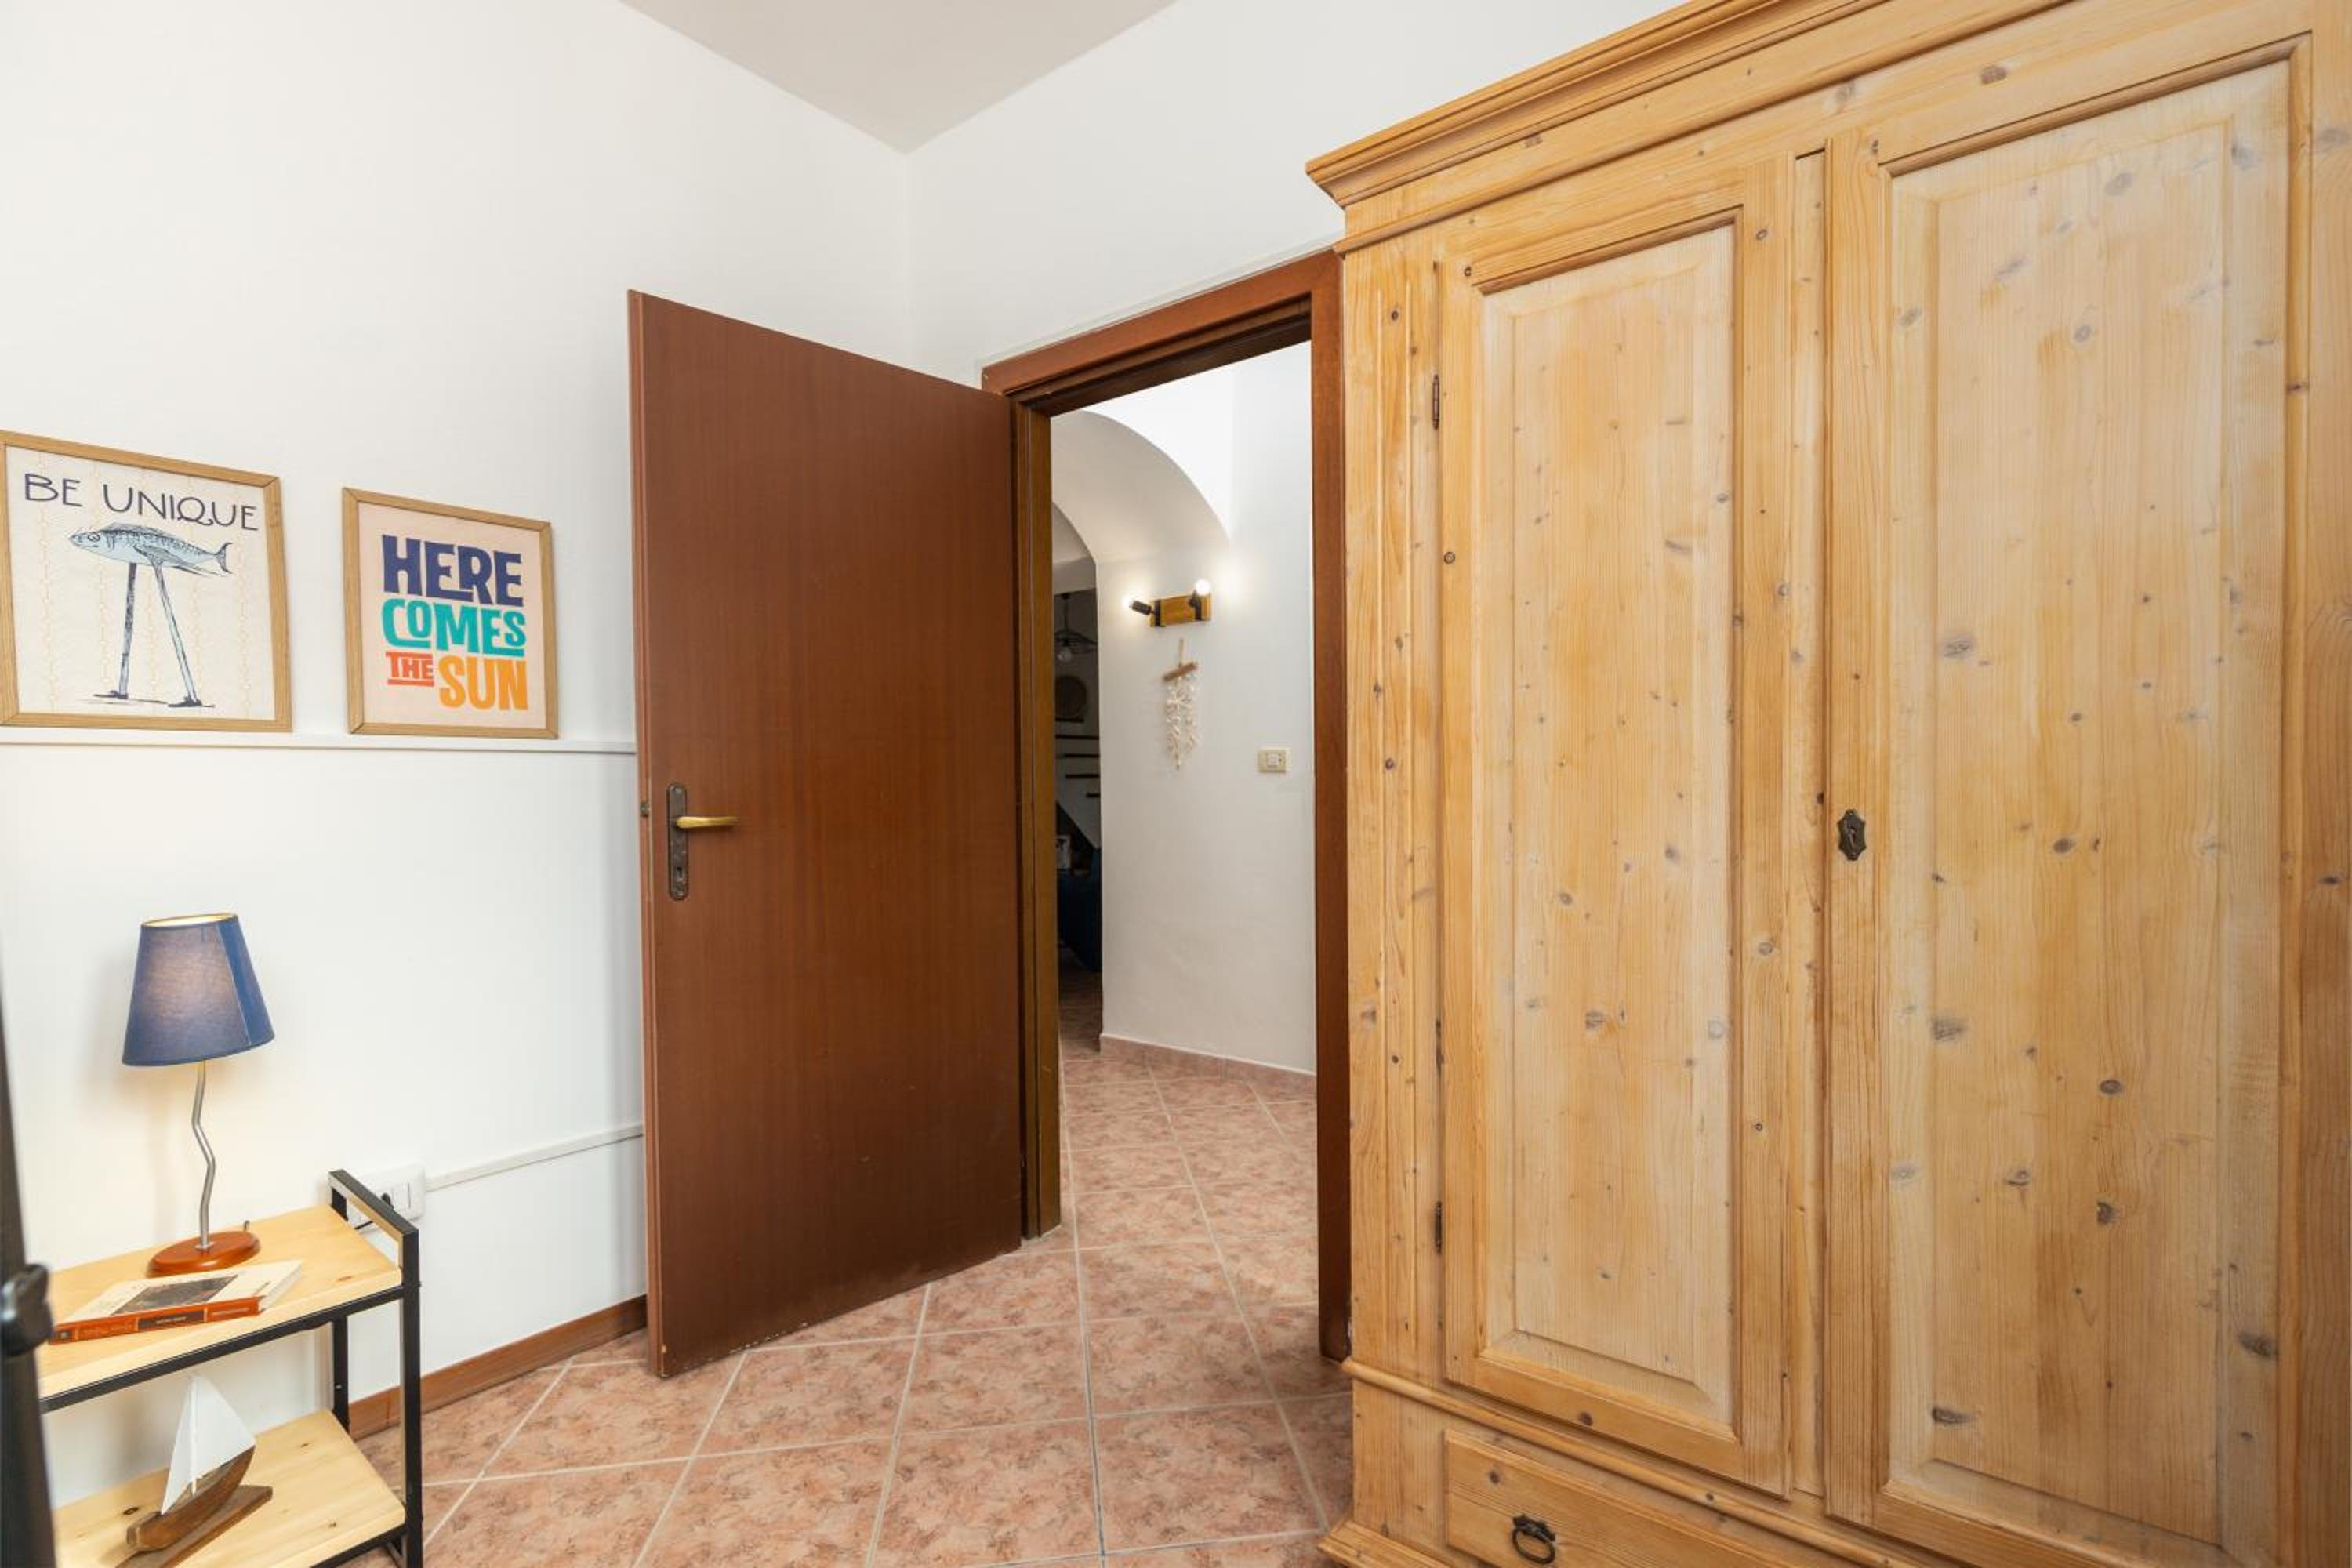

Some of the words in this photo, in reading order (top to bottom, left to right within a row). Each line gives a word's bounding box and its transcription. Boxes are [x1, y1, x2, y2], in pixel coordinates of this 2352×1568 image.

[24, 473, 82, 507] BE
[103, 483, 258, 532] UNIQUE
[381, 534, 524, 608] HERE
[382, 597, 526, 657] COMES
[385, 652, 435, 682] THE
[439, 655, 528, 711] SUN
